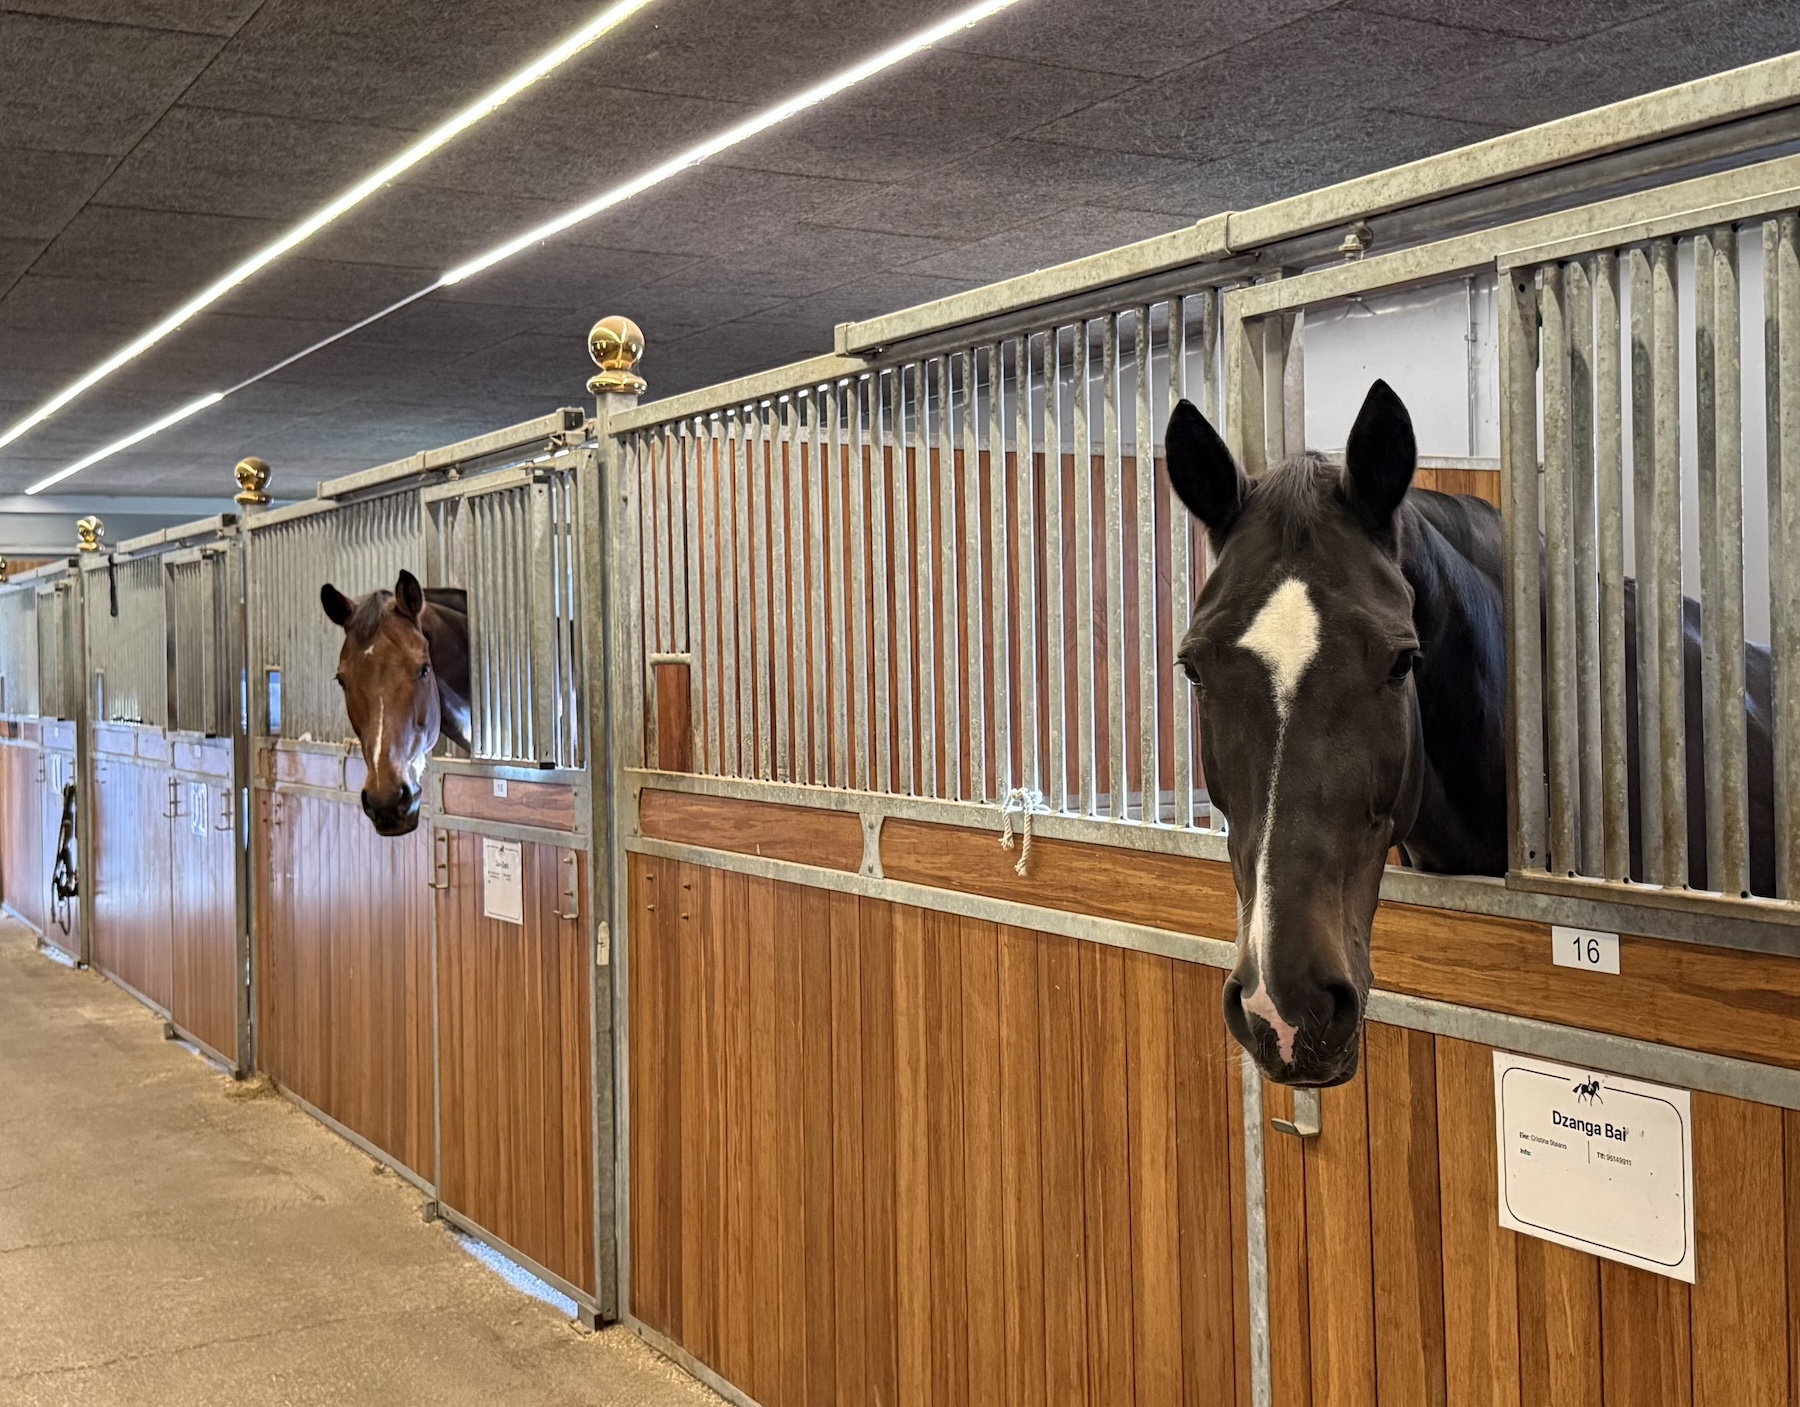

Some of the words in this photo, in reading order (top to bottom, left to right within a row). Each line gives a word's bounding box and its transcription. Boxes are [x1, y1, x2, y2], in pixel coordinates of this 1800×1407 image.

[1572, 936, 1600, 964] 16
[1552, 1110, 1601, 1137] Dzanga
[1605, 1123, 1626, 1142] Bai
